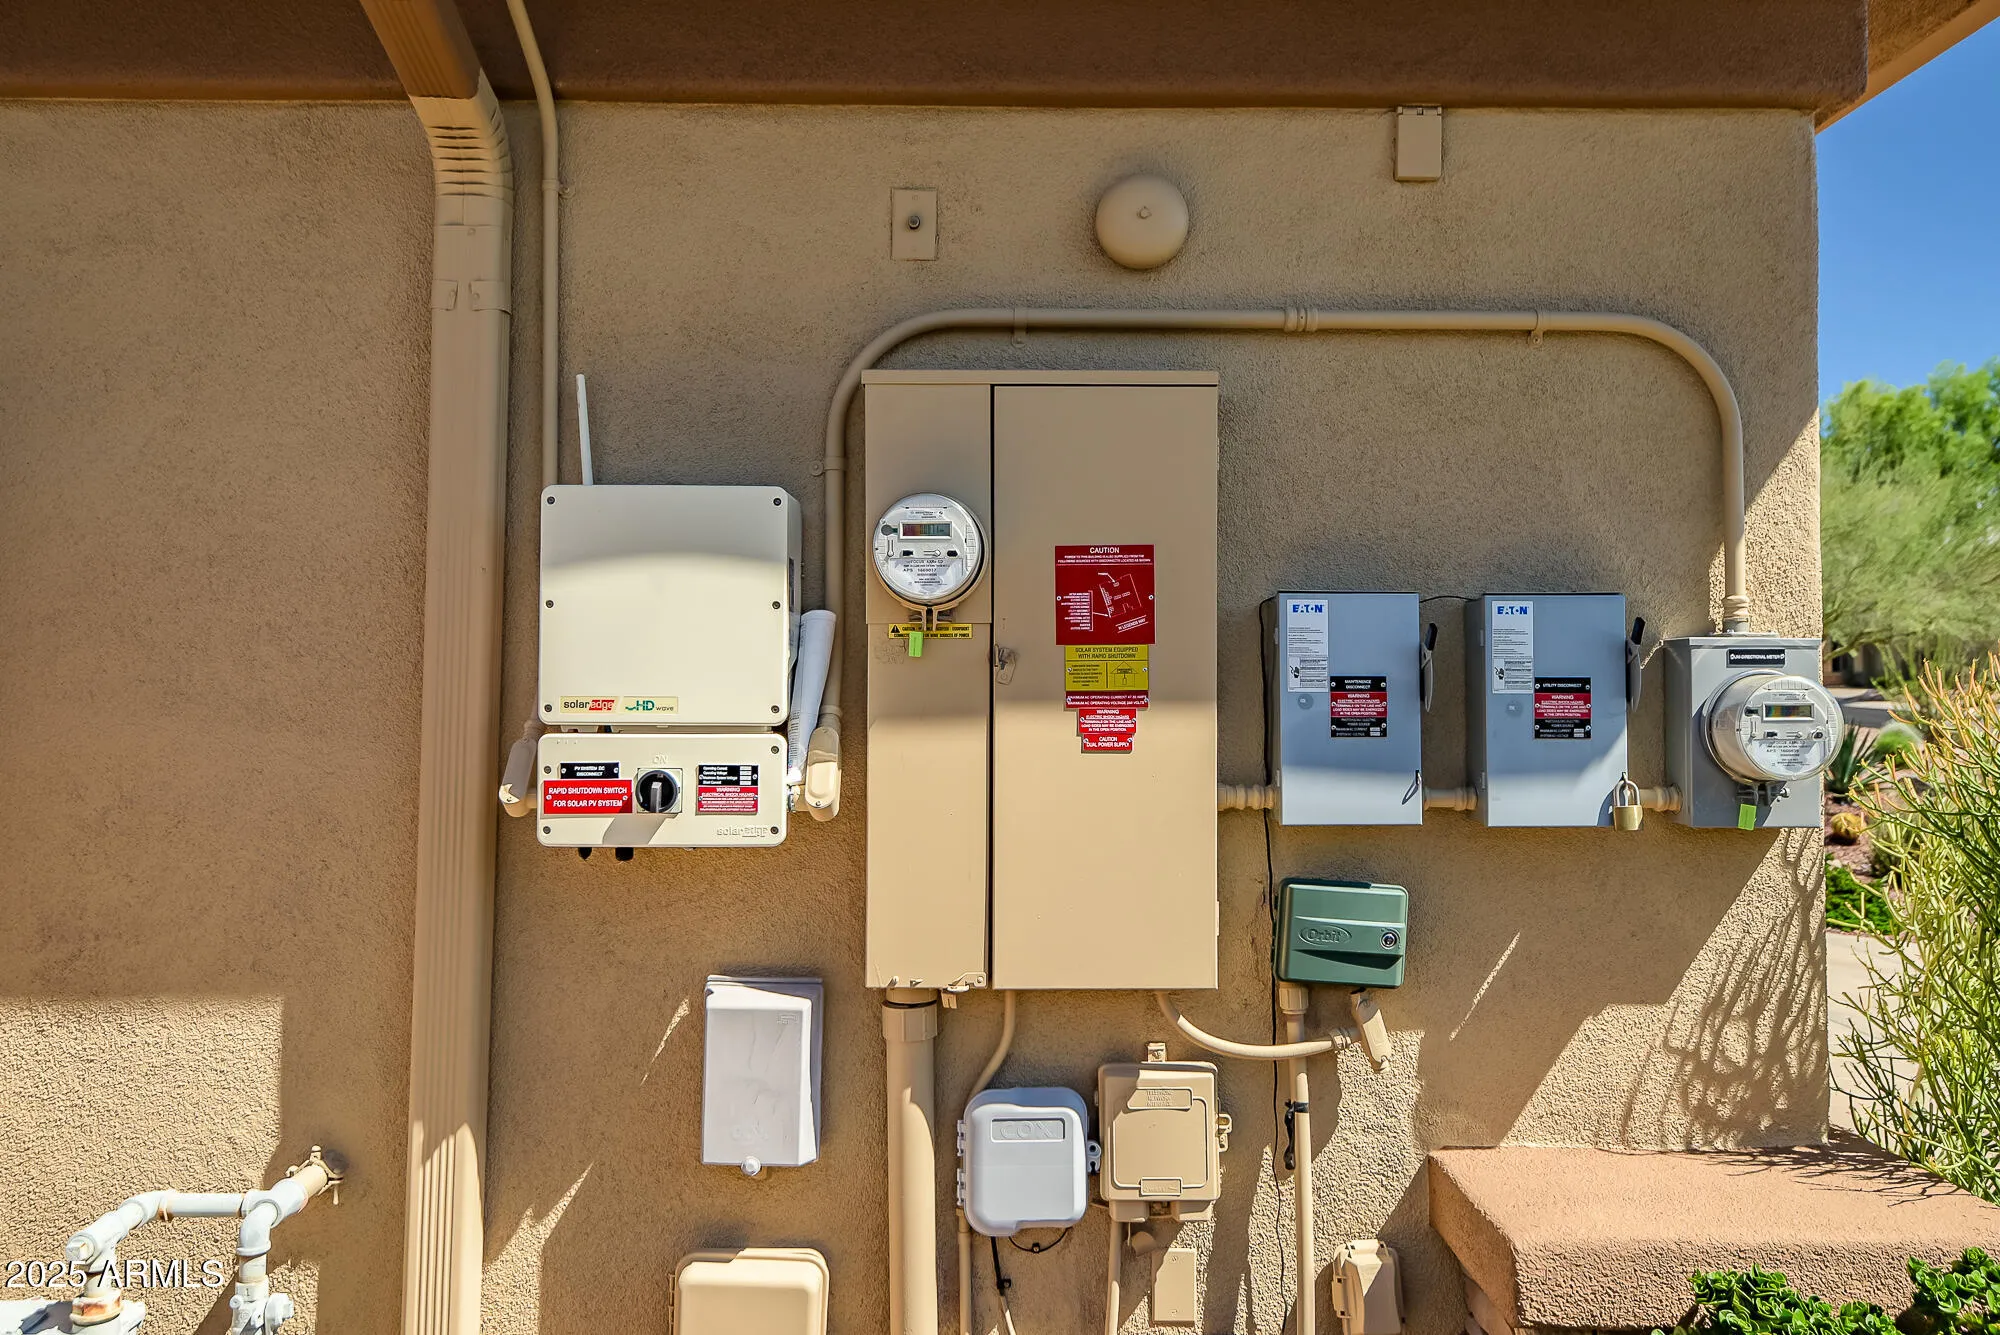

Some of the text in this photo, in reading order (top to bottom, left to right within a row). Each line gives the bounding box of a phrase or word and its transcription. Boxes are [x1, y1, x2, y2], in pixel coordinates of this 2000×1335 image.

[564, 700, 614, 710] solaredge
[637, 700, 654, 710] HD
[653, 754, 668, 764] ON
[1306, 928, 1340, 943] Orbit
[1000, 1121, 1054, 1138] COX
